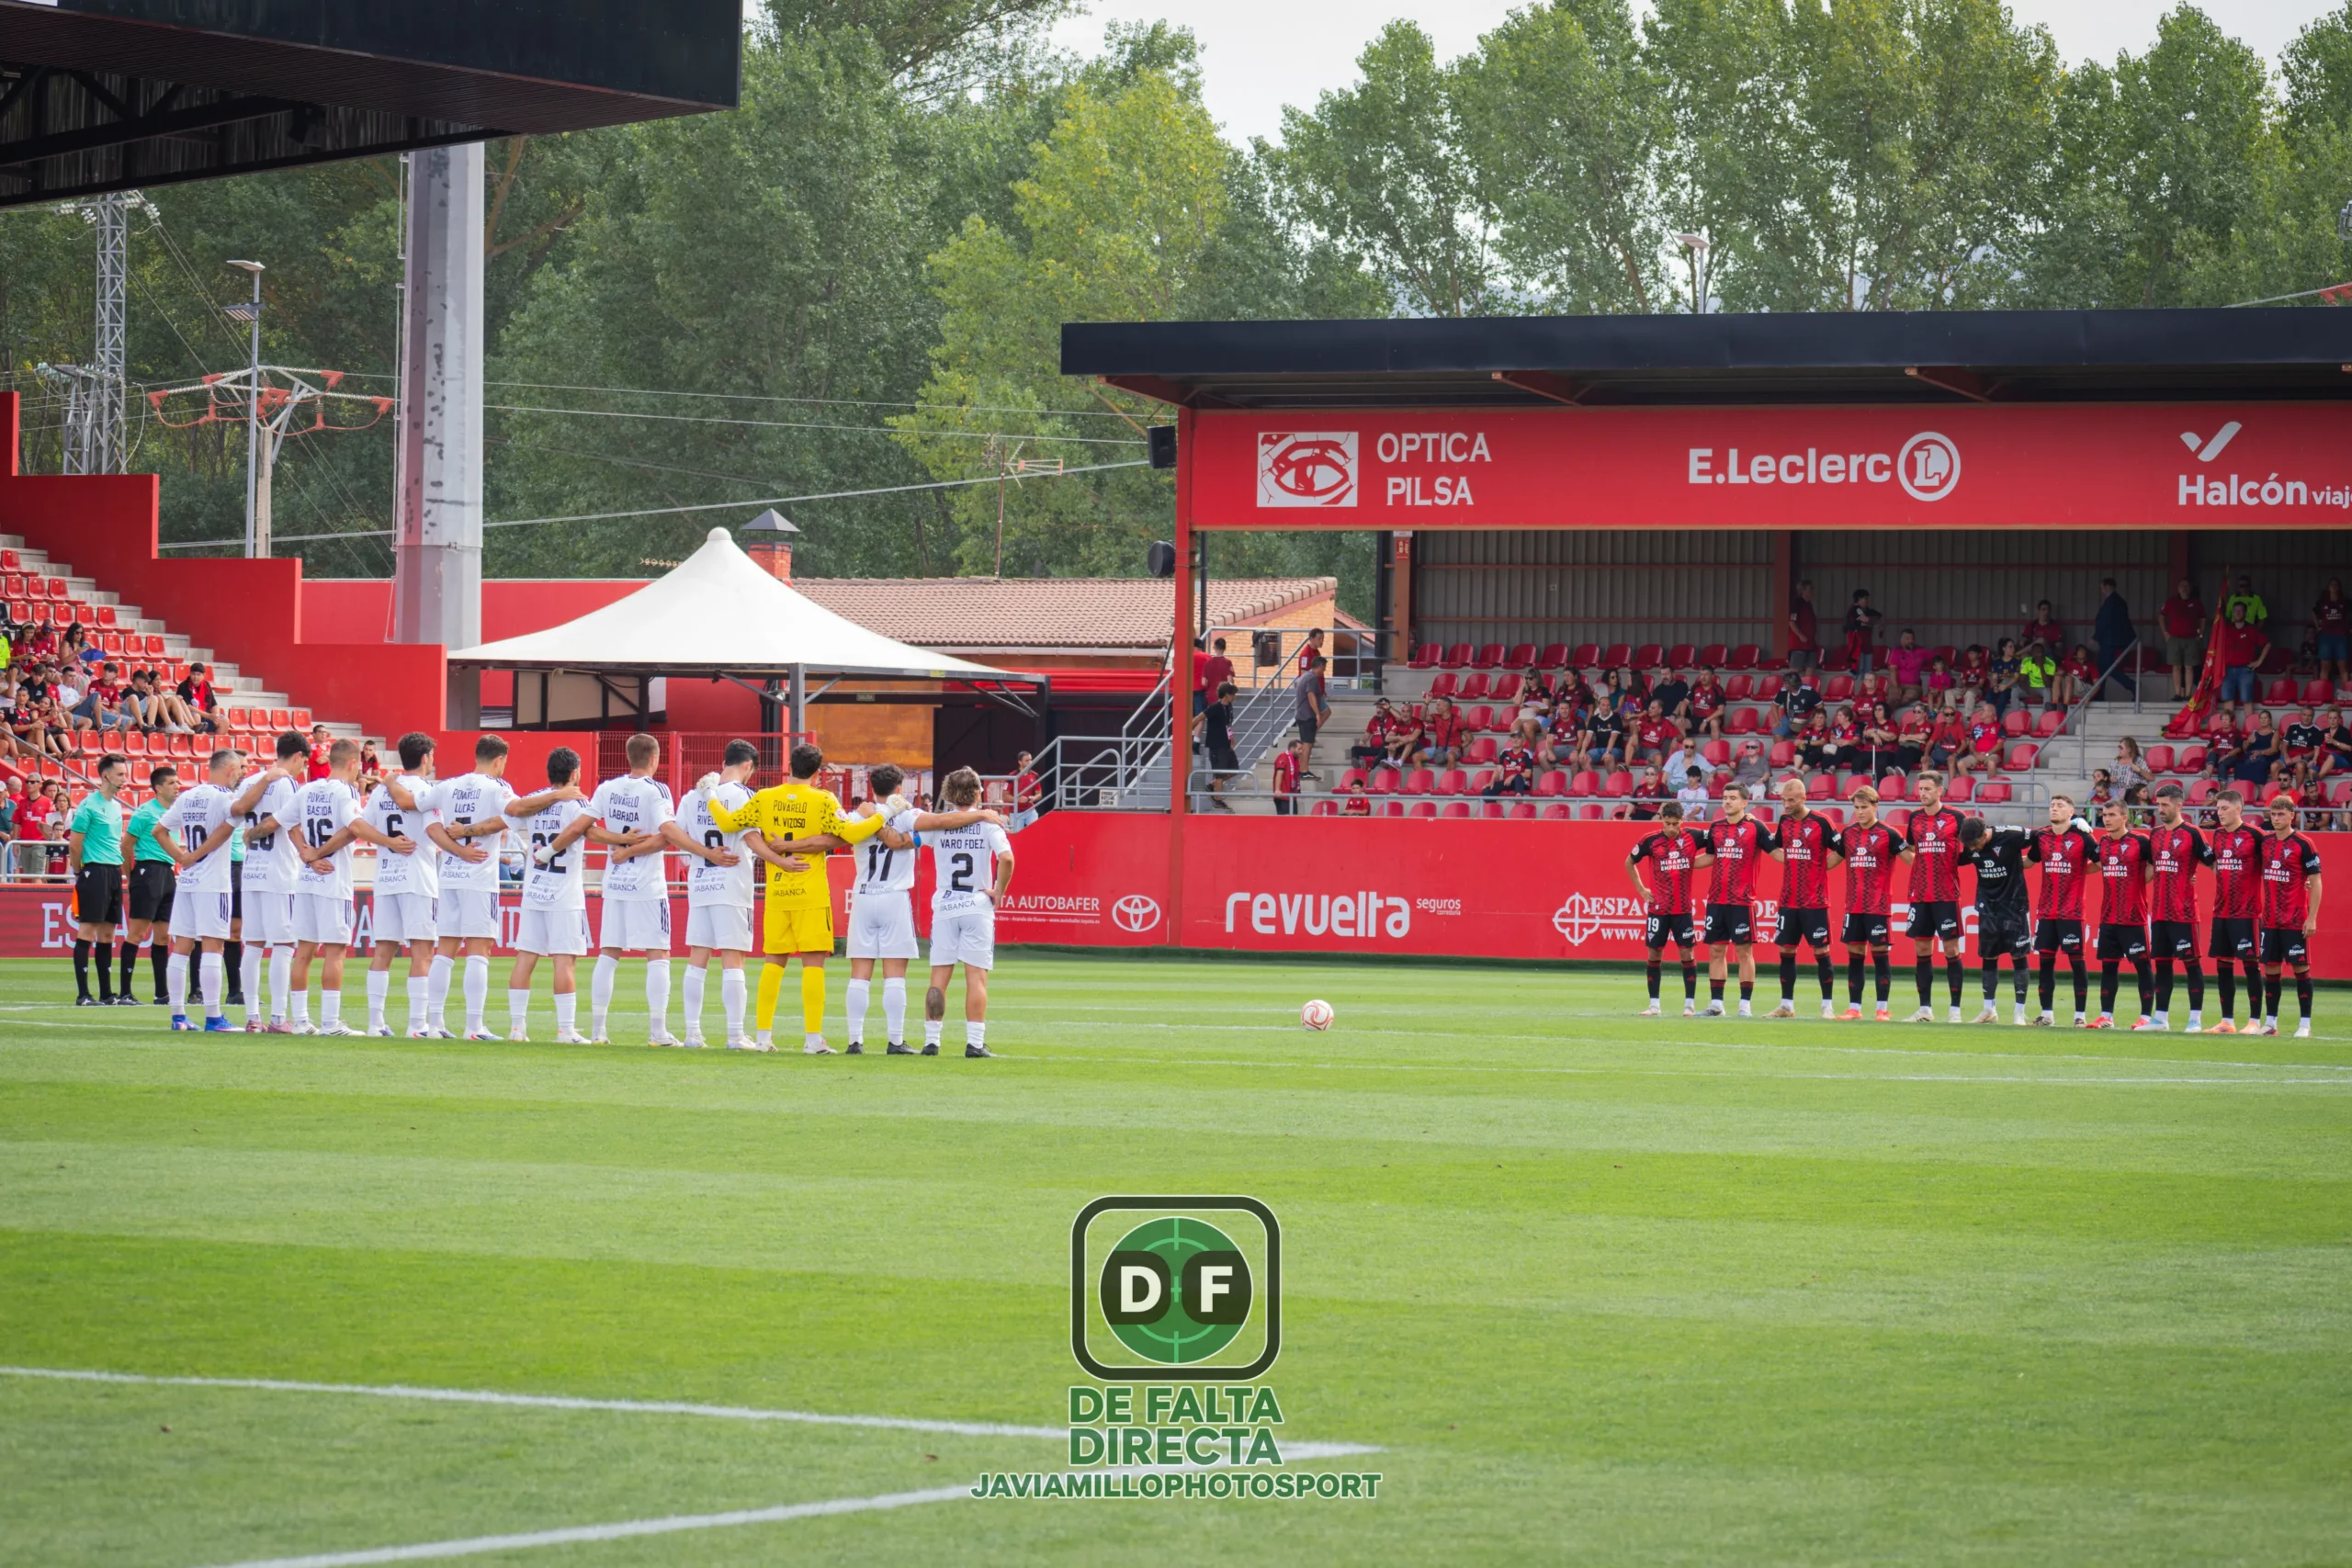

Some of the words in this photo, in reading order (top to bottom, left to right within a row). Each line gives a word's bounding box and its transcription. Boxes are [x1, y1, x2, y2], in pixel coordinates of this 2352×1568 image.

[1377, 432, 1492, 463] OPTICA
[1689, 447, 1892, 484] E.Leclerc
[1386, 477, 1475, 506] PILSA
[2178, 472, 2308, 505] Halcón
[2312, 485, 2352, 509] viaj
[454, 803, 476, 813] LUCAS
[774, 800, 807, 813] POVARELO
[608, 808, 639, 822] LABRADA
[774, 817, 781, 826] M.
[783, 818, 806, 829] VIZOSO
[185, 825, 208, 863] 10
[307, 818, 334, 858] 16
[941, 839, 962, 849] VARO
[965, 839, 985, 849] FDEZ.
[532, 833, 566, 874] 22
[868, 844, 893, 882] 17
[1660, 858, 1689, 866] MIRANDA
[952, 853, 974, 893] 2
[773, 888, 807, 897] ABANCA
[940, 899, 977, 911] ABANCA
[1018, 896, 1100, 911] AUTOBAFER
[1416, 897, 1461, 912] seguros
[1226, 891, 1410, 938] revuelta
[1647, 917, 1659, 932] 19
